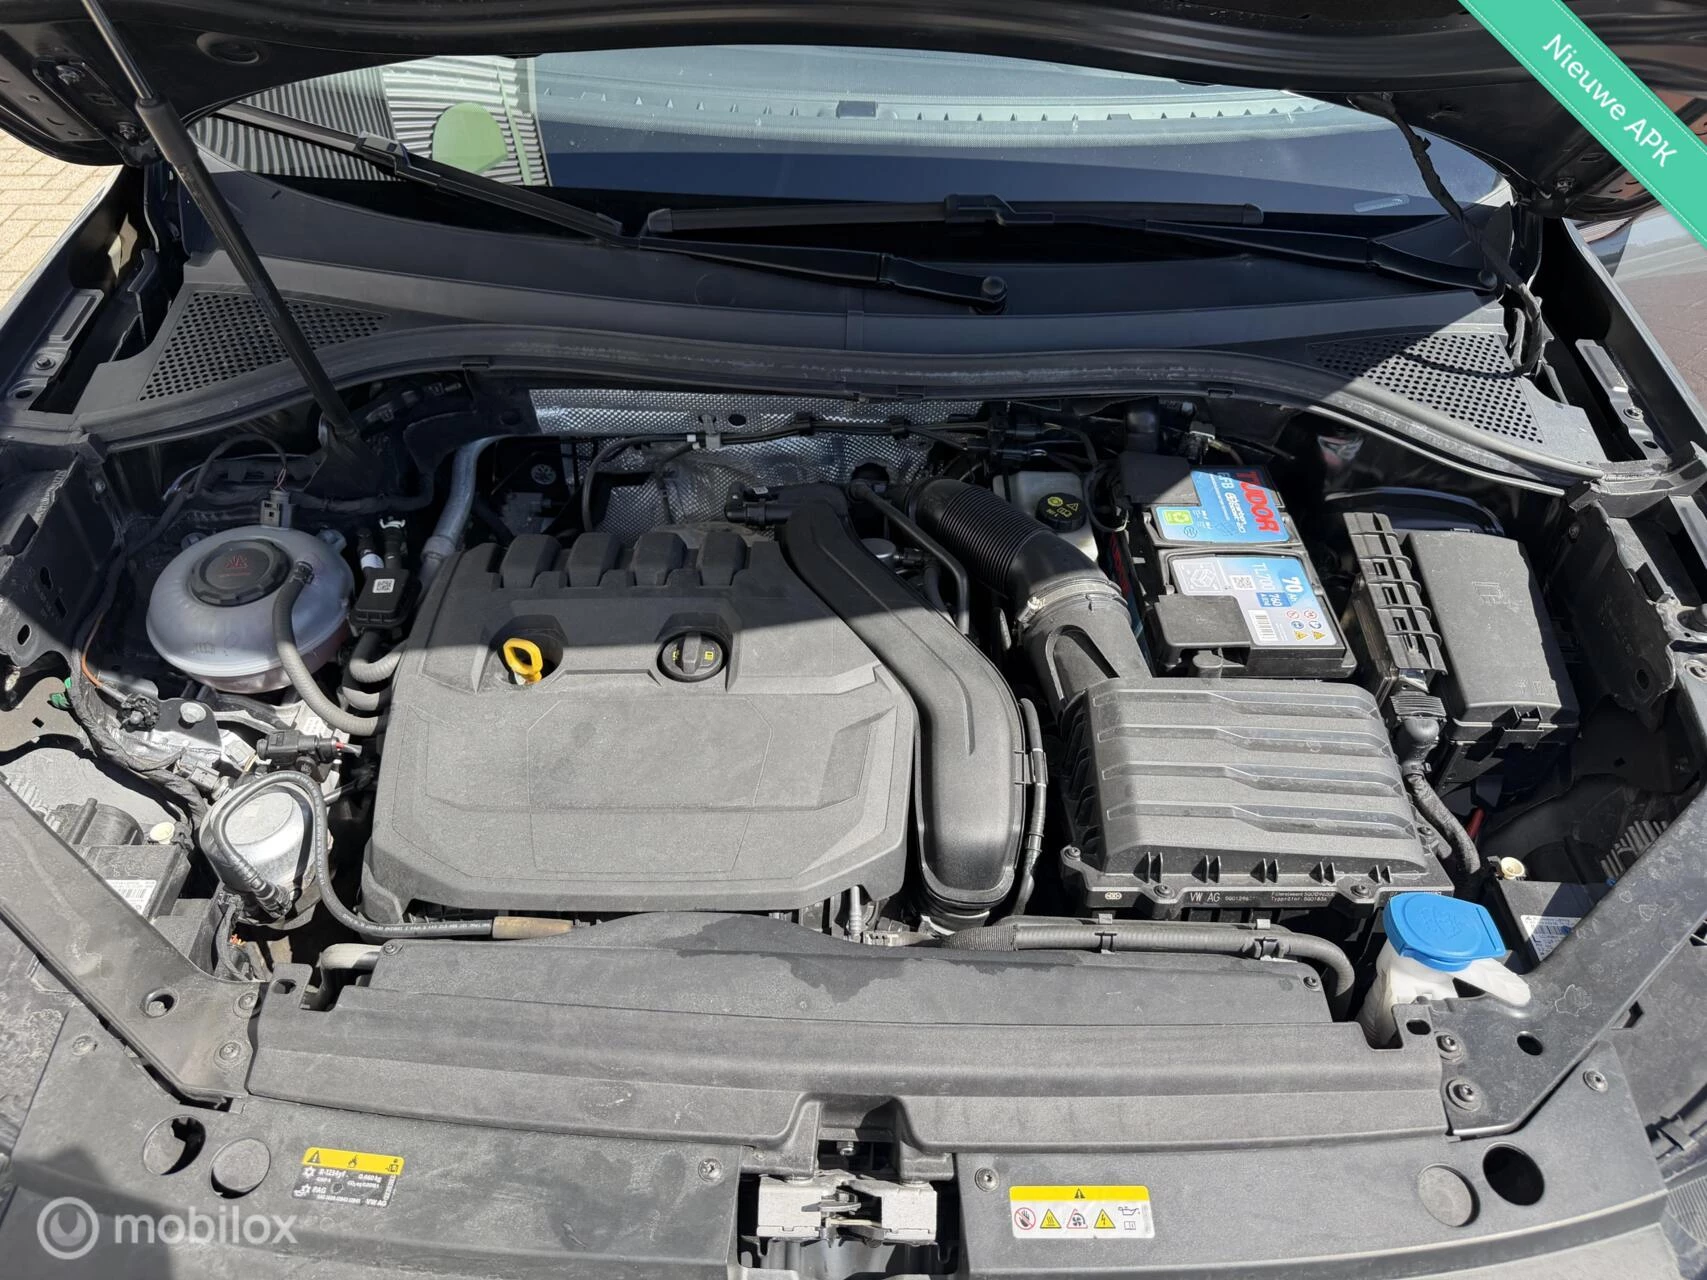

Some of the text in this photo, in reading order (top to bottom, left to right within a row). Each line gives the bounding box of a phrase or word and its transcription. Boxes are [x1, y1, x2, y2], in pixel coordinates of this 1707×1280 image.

[1235, 470, 1280, 534] TUDOR
[1251, 562, 1275, 591] TL700
[1281, 576, 1305, 593] 70
[1189, 892, 1221, 902] VW AG
